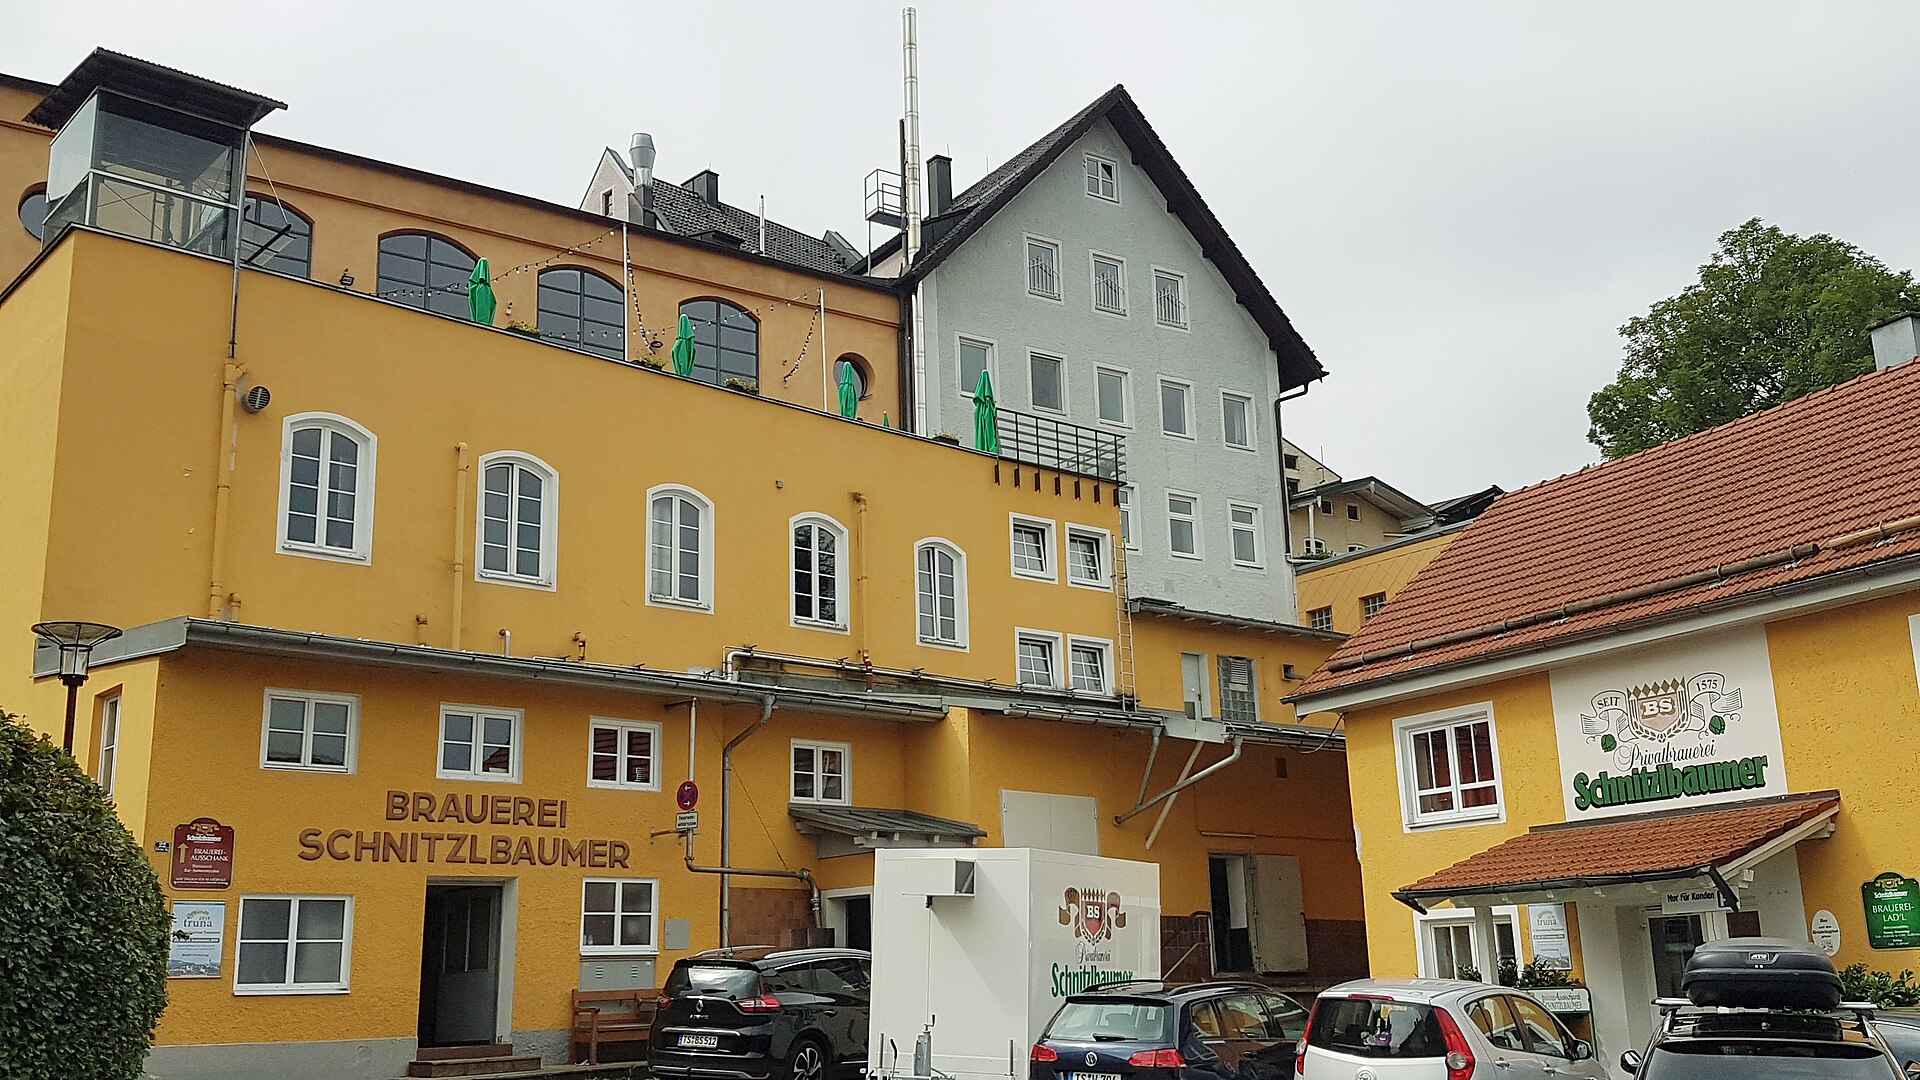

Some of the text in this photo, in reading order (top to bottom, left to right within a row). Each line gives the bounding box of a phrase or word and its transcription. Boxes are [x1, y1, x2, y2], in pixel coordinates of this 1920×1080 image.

[1696, 679, 1718, 692] 1575
[1597, 696, 1620, 709] SEIT
[1642, 697, 1675, 717] BS
[1613, 740, 1716, 773] Privatbrauerei
[1573, 754, 1768, 811] Schnitzlbaumer
[385, 790, 567, 829] BRAUEREI
[297, 827, 630, 869] SCHNITZLBAUMER
[190, 854, 229, 862] AUSSCHANK
[1692, 891, 1715, 901] Kunden
[1086, 905, 1100, 919] BS
[1872, 903, 1915, 913] BRAUEREI-
[183, 919, 213, 927] truna
